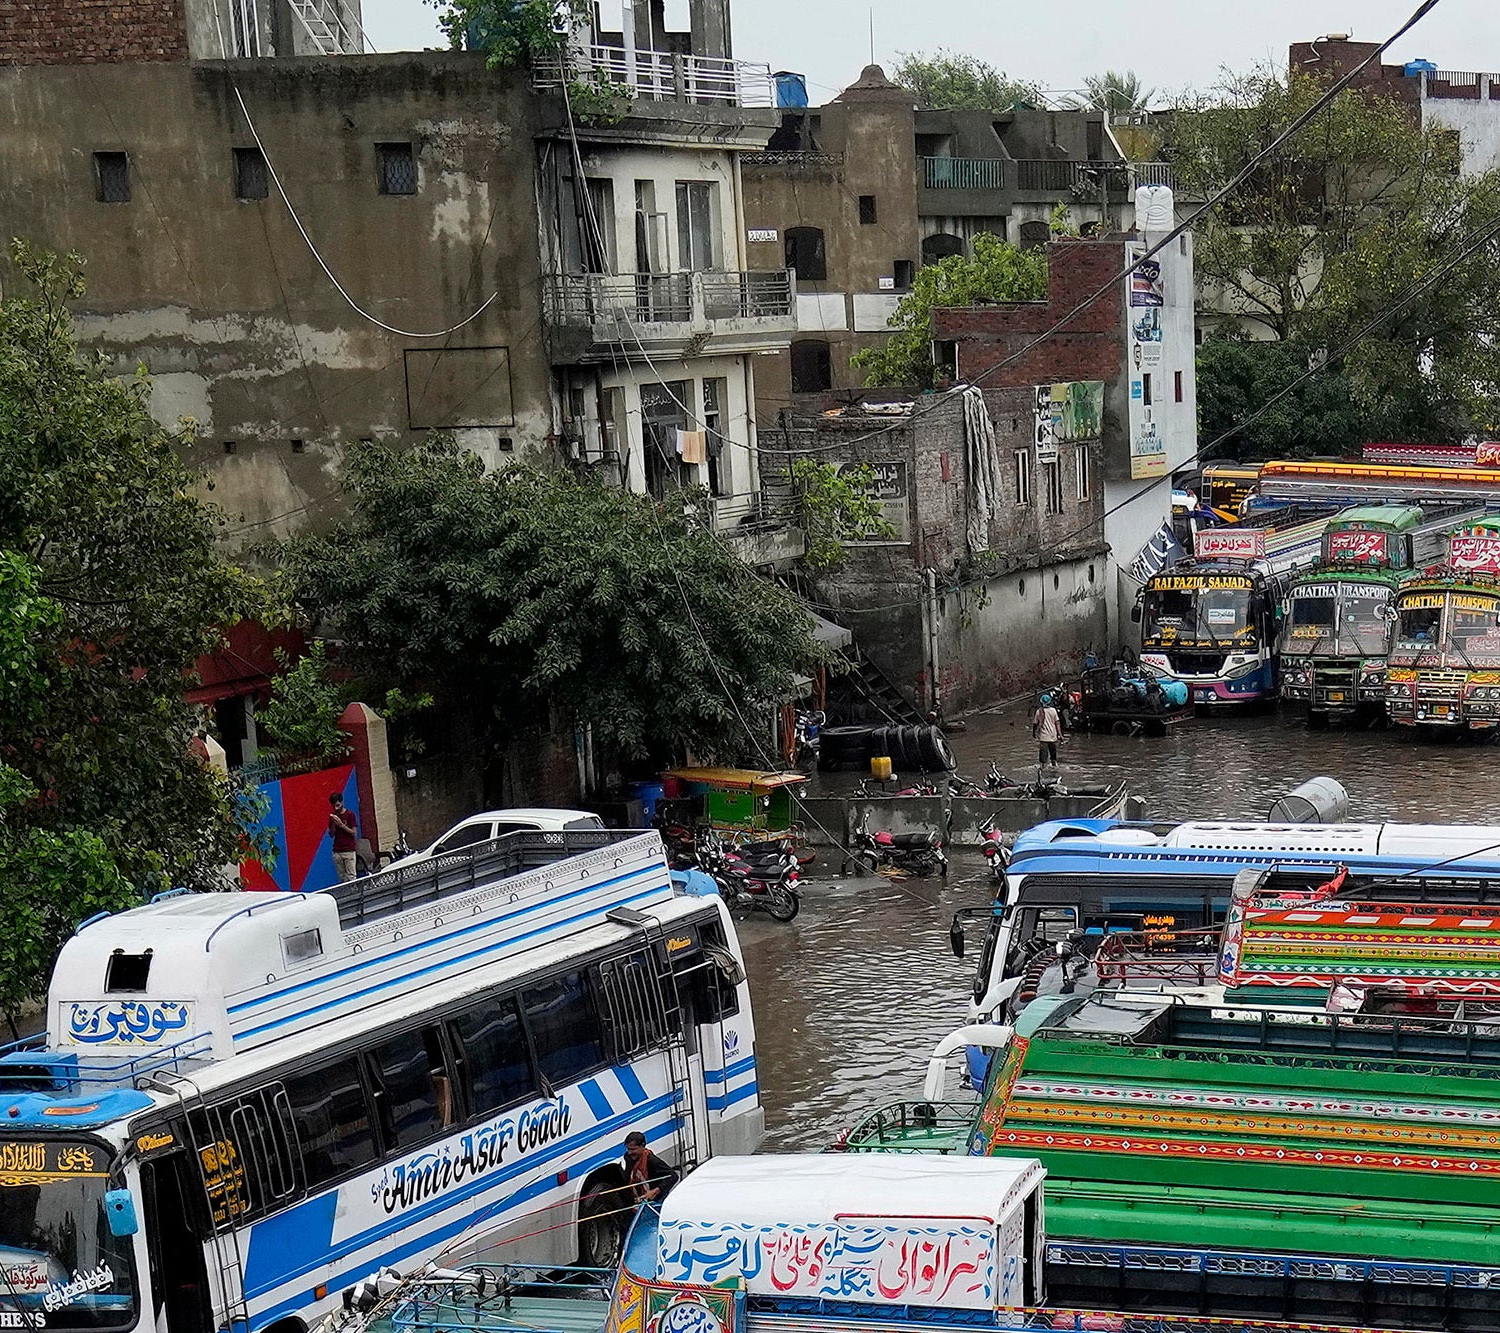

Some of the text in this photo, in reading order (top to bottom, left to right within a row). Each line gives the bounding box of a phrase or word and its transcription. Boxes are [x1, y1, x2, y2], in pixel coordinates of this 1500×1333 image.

[1154, 576, 1246, 589] RAI FAZUL SAJJAD
[1294, 585, 1389, 600] CHATTHA TRANSPORT
[1403, 595, 1497, 611] CHATTHA TRANSPORT
[371, 1096, 572, 1214] Syed Amir Asif Coach
[664, 1231, 763, 1281] لاہور
